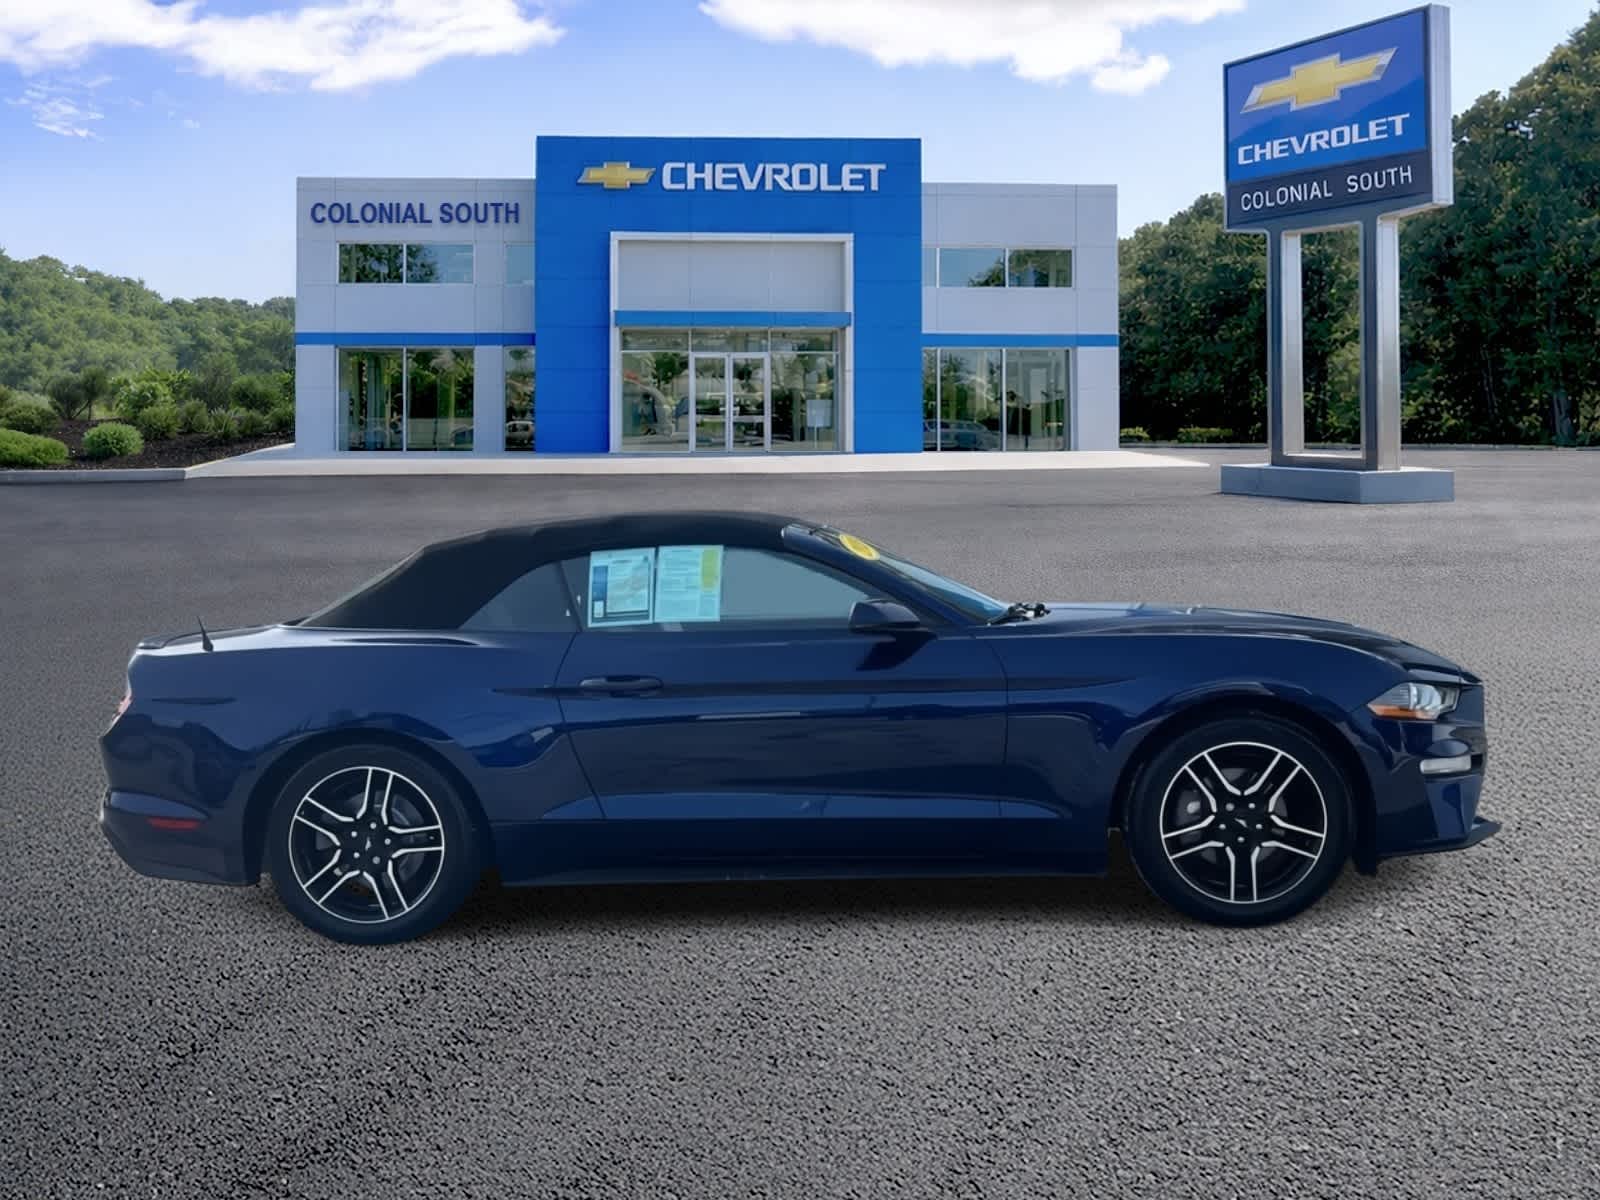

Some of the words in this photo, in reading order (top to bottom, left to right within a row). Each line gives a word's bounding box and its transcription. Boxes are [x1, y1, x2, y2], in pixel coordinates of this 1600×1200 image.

[1237, 113, 1410, 165] CHEVROLET
[661, 162, 886, 192] CHEVROLET
[1240, 179, 1333, 212] COLONIAL
[1346, 165, 1413, 193] SOUTH
[310, 202, 432, 225] COLONIAL
[438, 202, 521, 225] SOUTH
